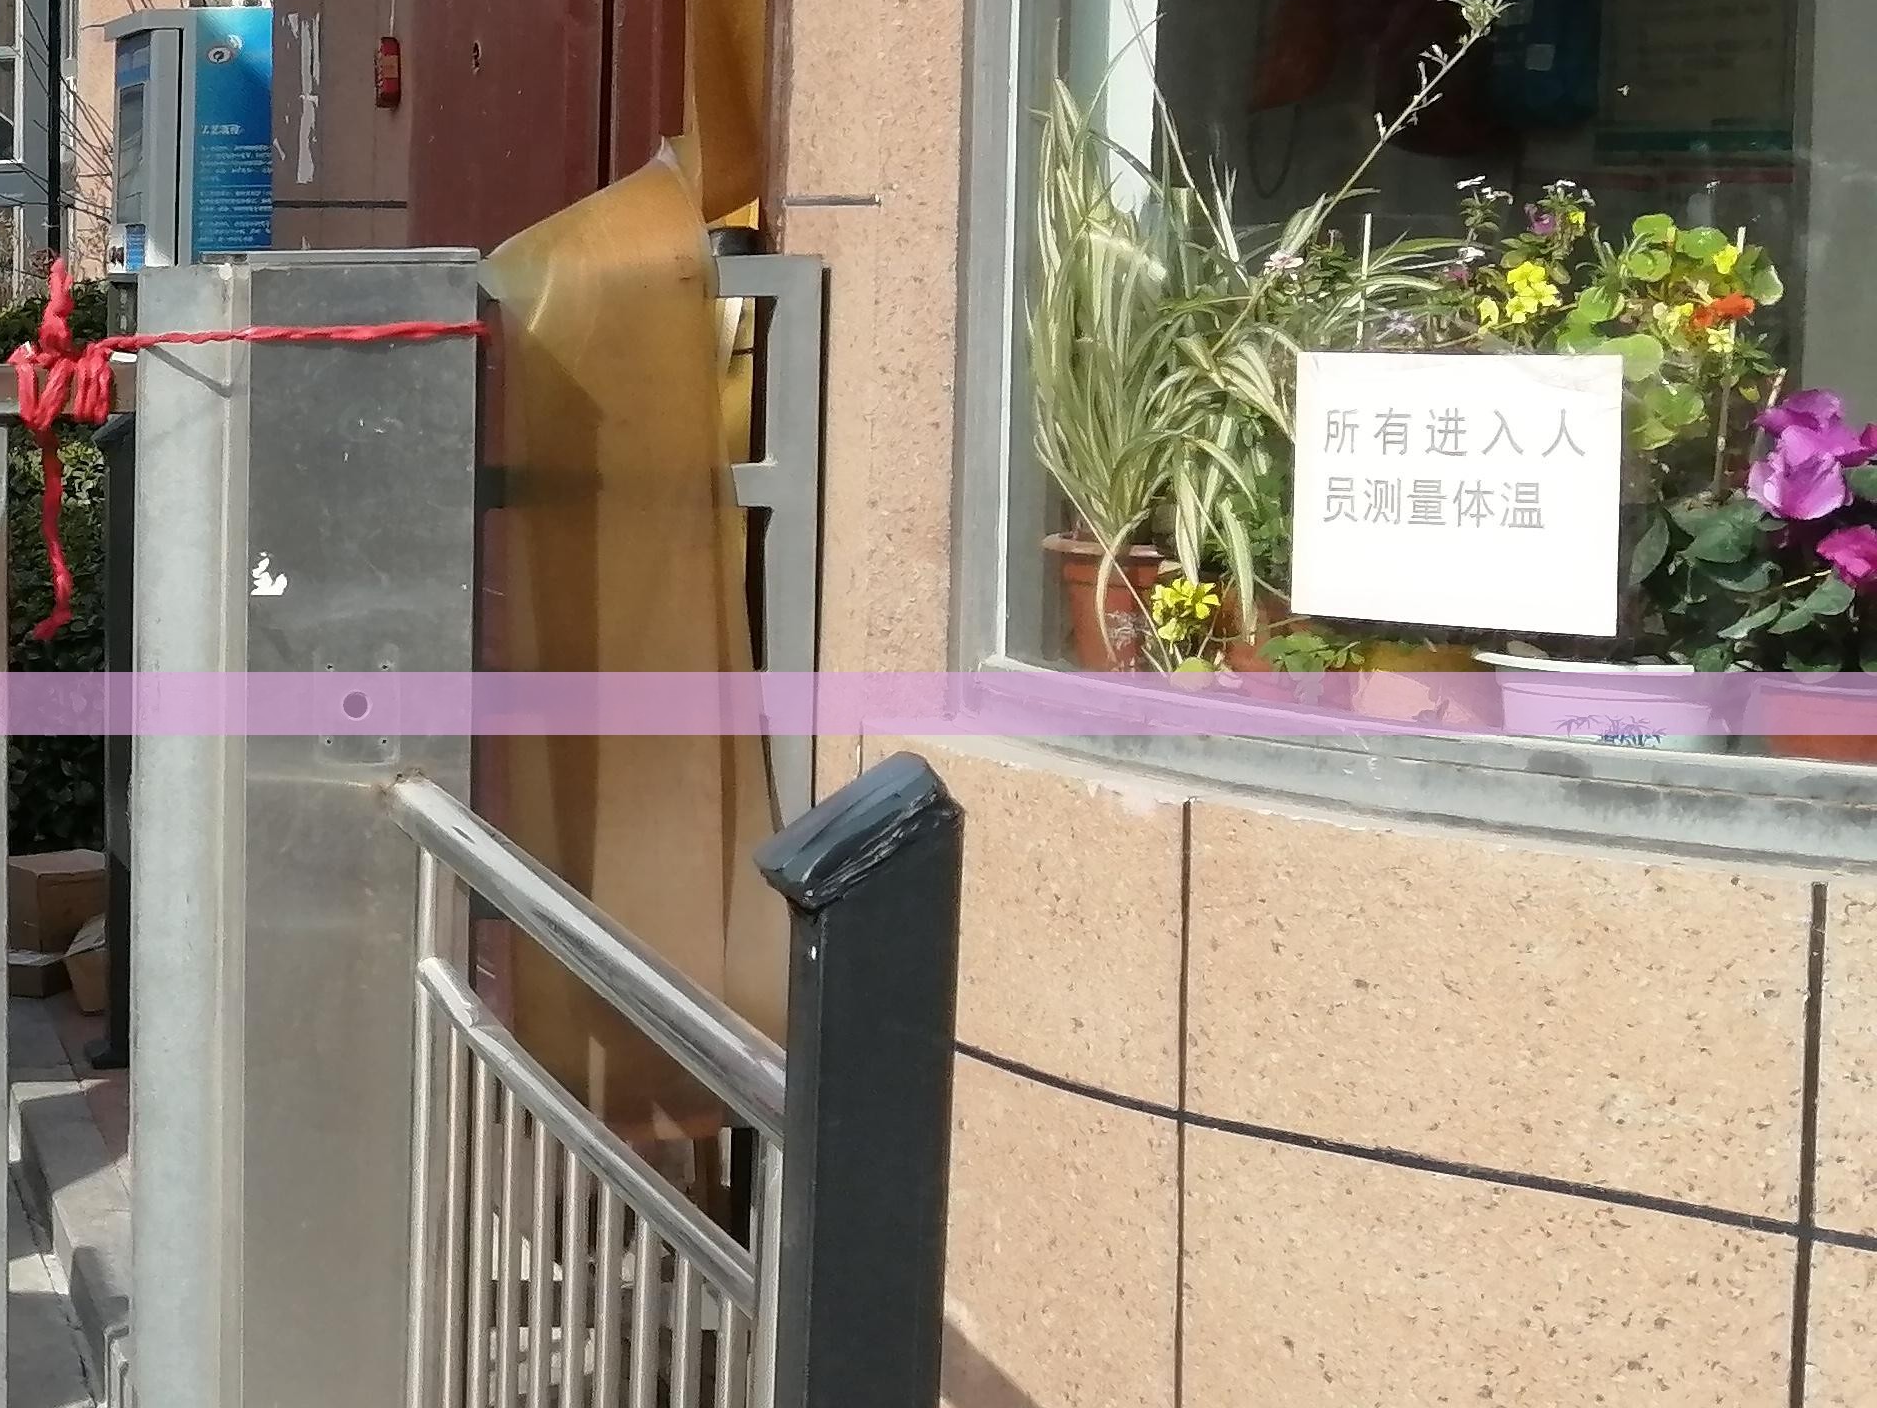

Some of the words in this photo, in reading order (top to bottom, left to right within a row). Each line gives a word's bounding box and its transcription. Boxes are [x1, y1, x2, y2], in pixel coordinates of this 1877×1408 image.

[1323, 408, 1586, 458] 所有进入人
[1322, 477, 1545, 529] 员测量体温
